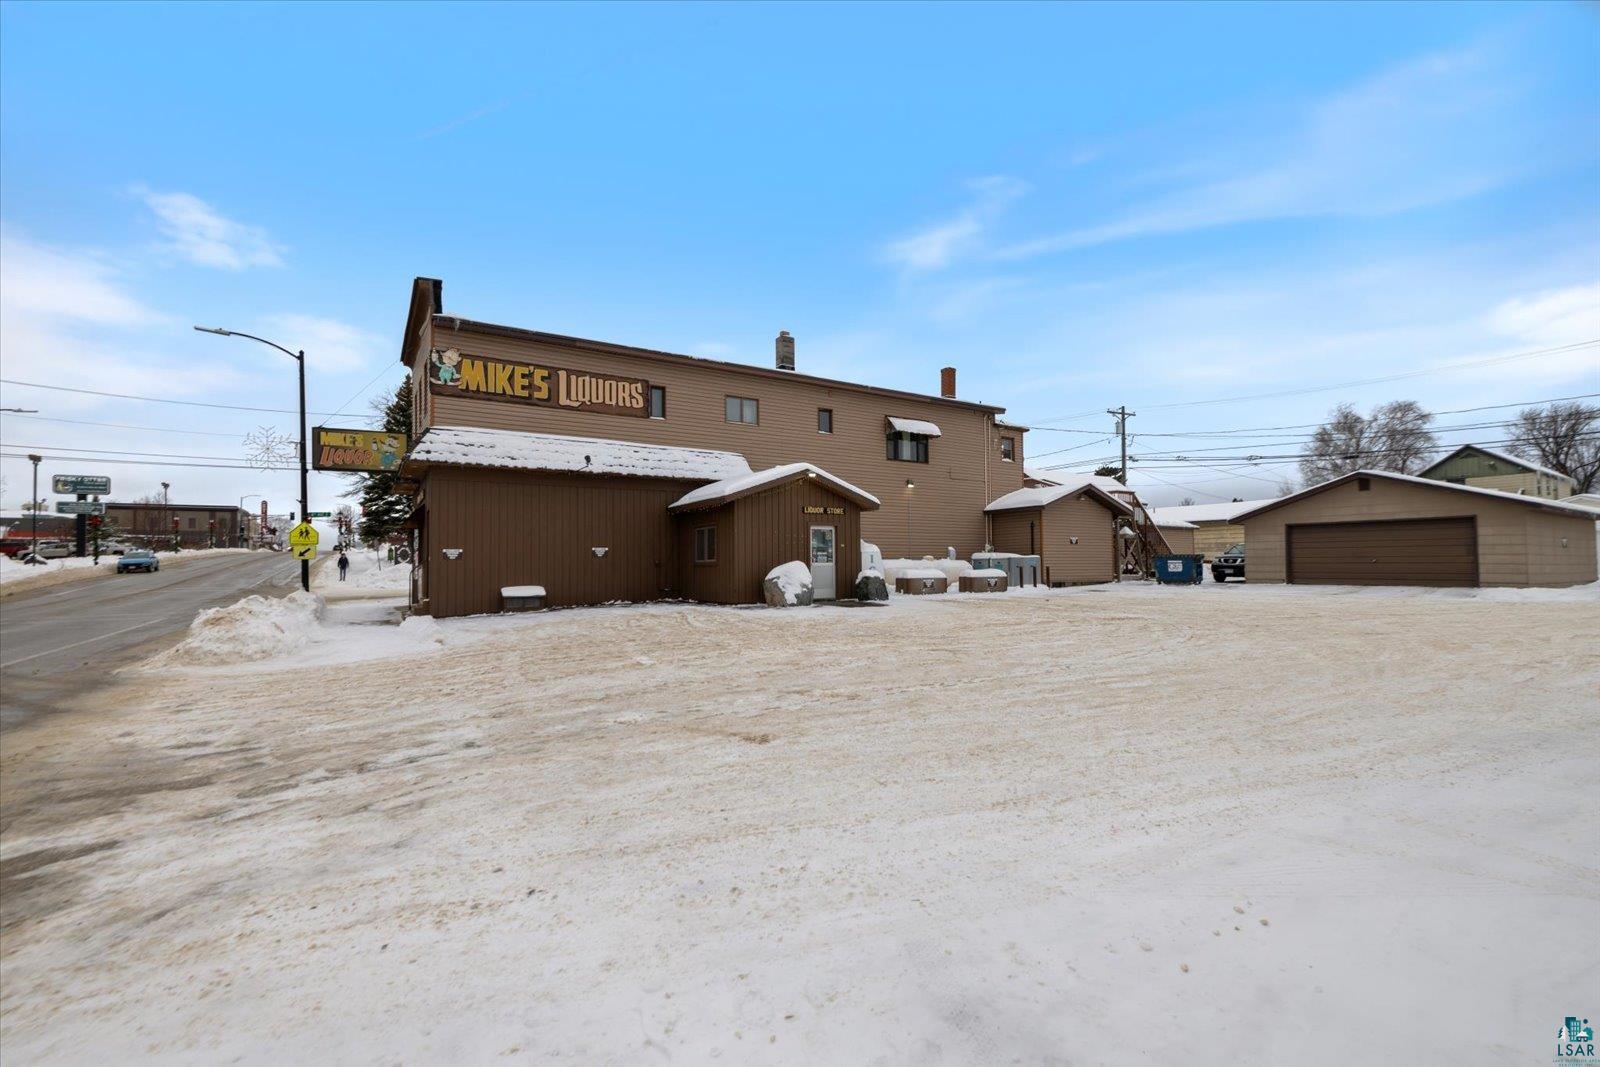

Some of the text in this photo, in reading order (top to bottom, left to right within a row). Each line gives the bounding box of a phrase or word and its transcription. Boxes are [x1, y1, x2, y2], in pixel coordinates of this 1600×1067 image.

[458, 359, 644, 409] MIKE'S LIQUORS
[804, 506, 845, 515] LIQUOR STORE
